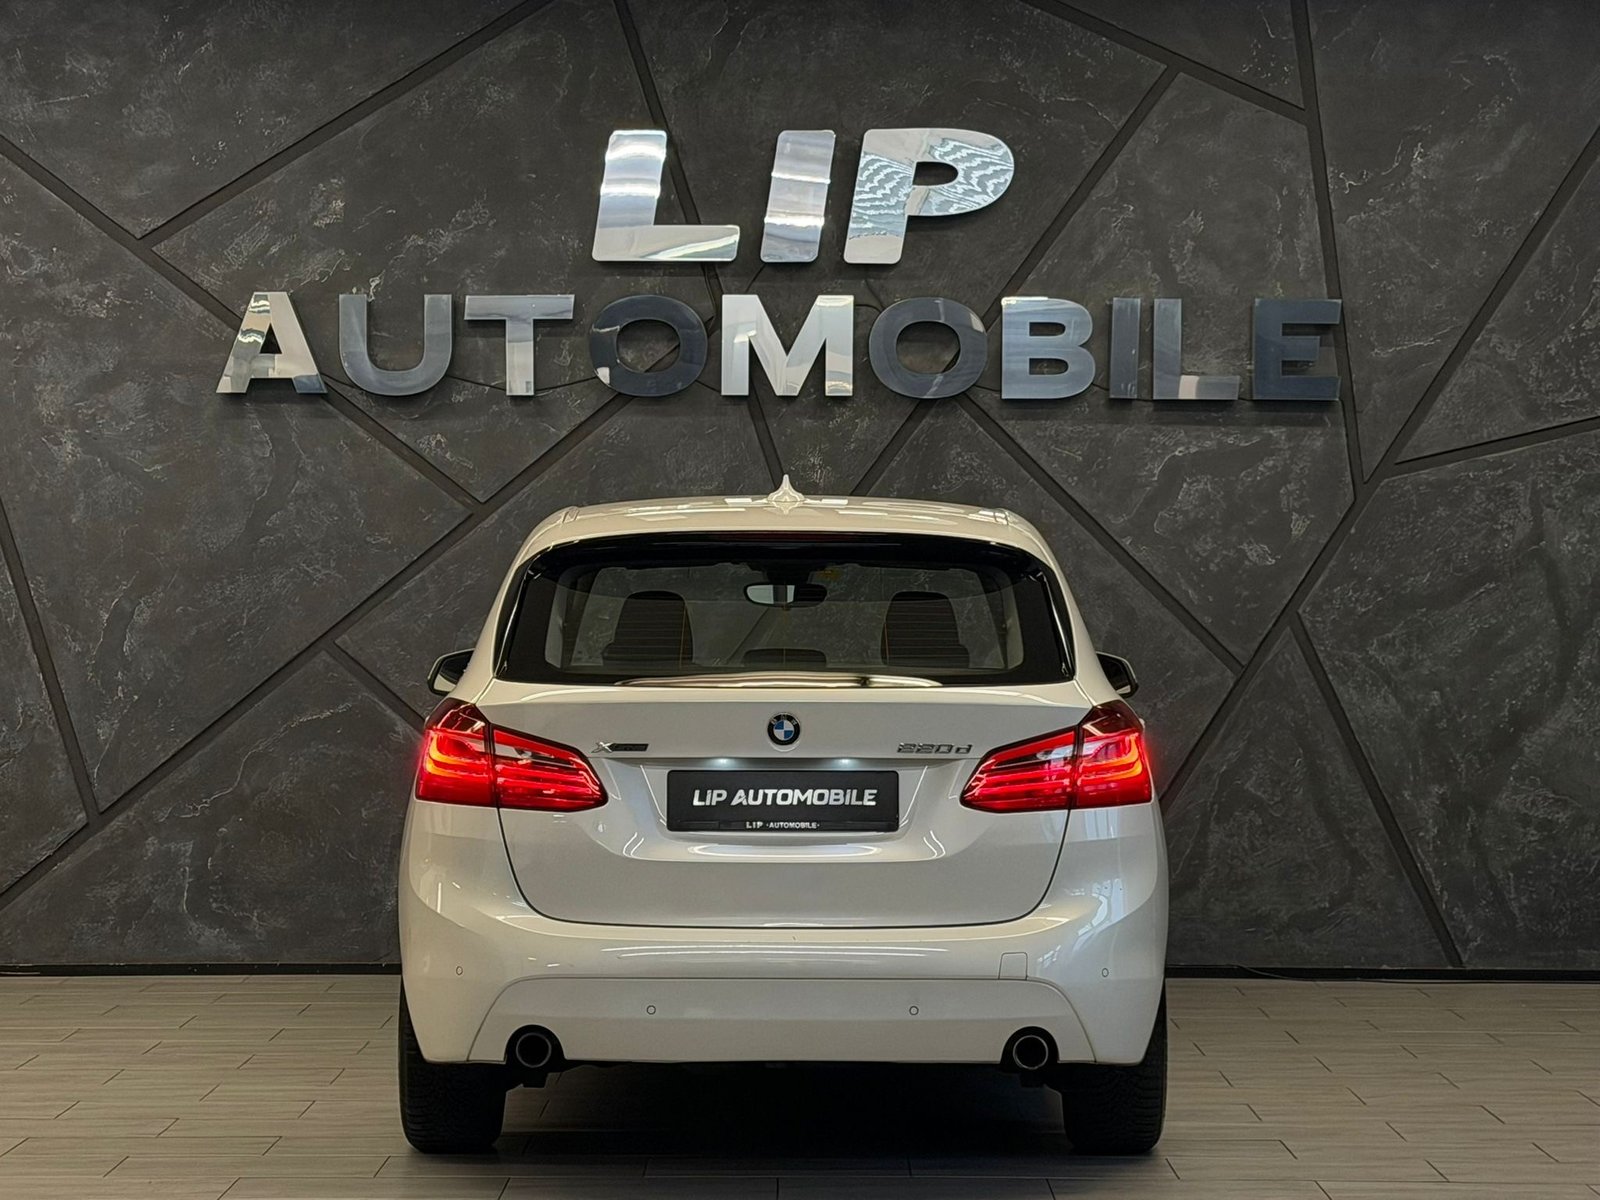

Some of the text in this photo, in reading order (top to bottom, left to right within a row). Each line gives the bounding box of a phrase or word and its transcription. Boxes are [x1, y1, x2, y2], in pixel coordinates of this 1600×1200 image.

[592, 128, 1015, 264] LIP
[217, 291, 1342, 401] AUTOMOBILE
[730, 789, 878, 806] AUTOMOBILE
[745, 821, 763, 829] LIP
